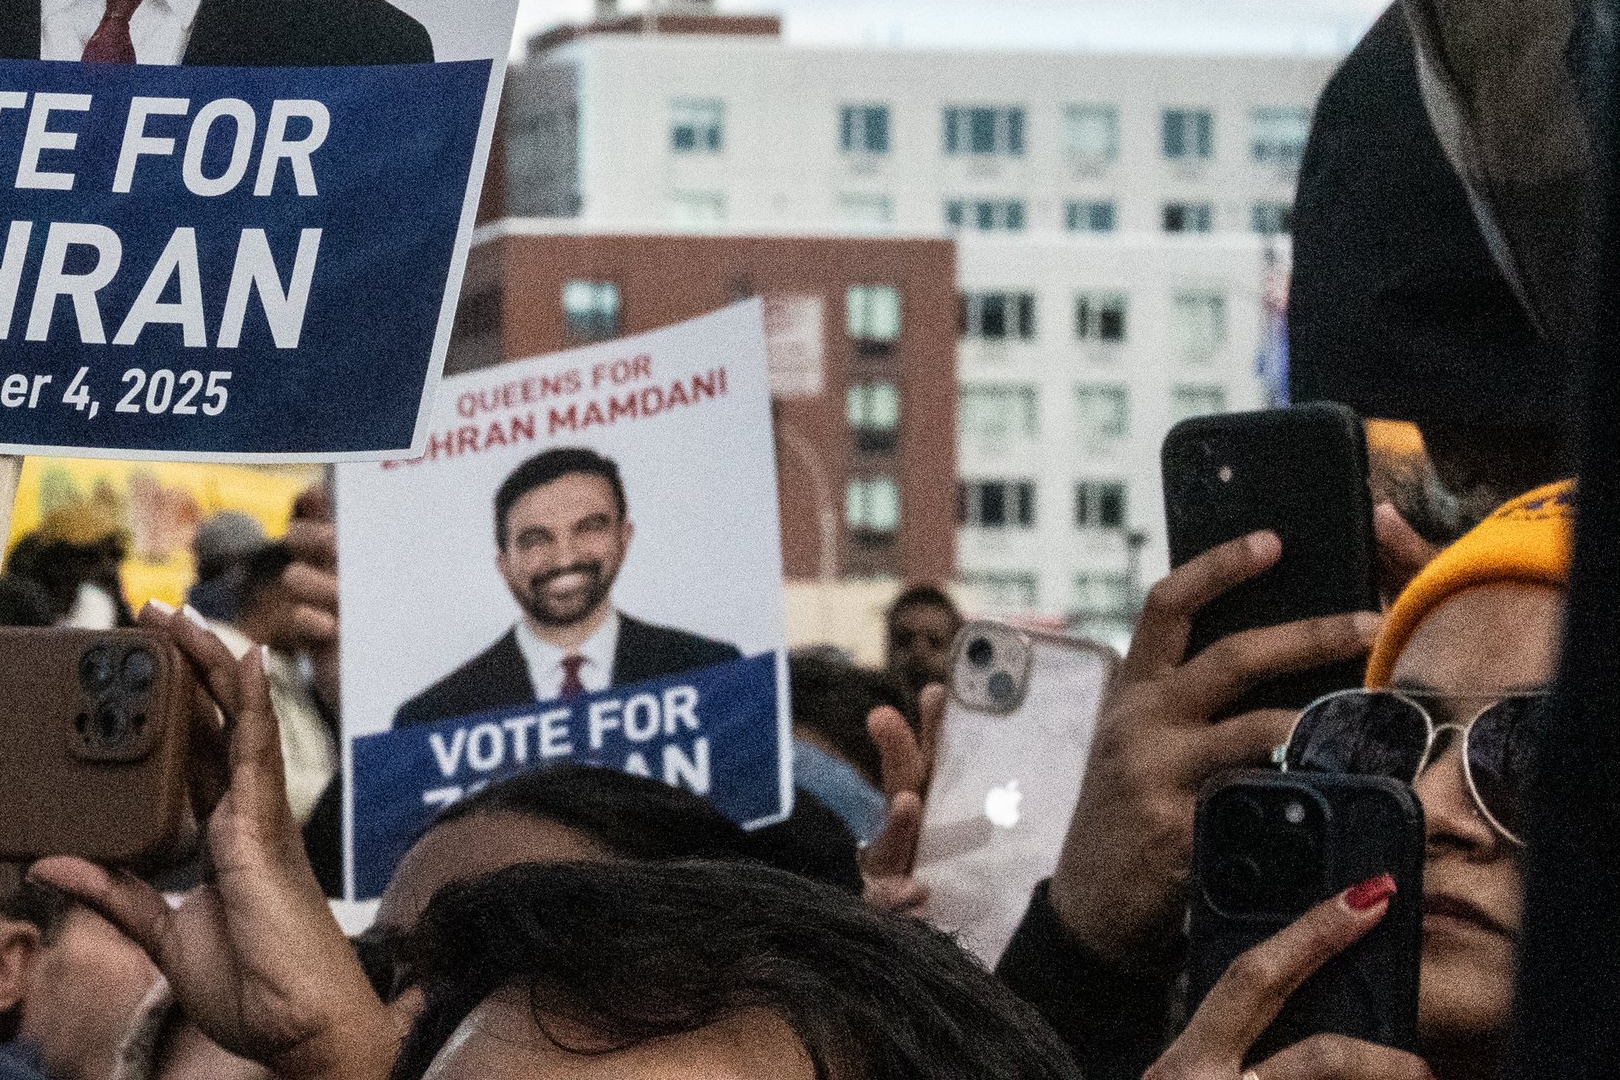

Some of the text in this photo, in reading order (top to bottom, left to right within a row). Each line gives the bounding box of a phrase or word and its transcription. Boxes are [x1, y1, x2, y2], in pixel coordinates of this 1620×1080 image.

[112, 95, 332, 197] FOR
[62, 366, 100, 420] 4,
[115, 367, 233, 416] 2025
[382, 366, 730, 469] HRAN MAMDANI
[456, 354, 653, 418] QUEENS FOR
[428, 707, 574, 778] VOTE
[588, 685, 700, 749] FOR
